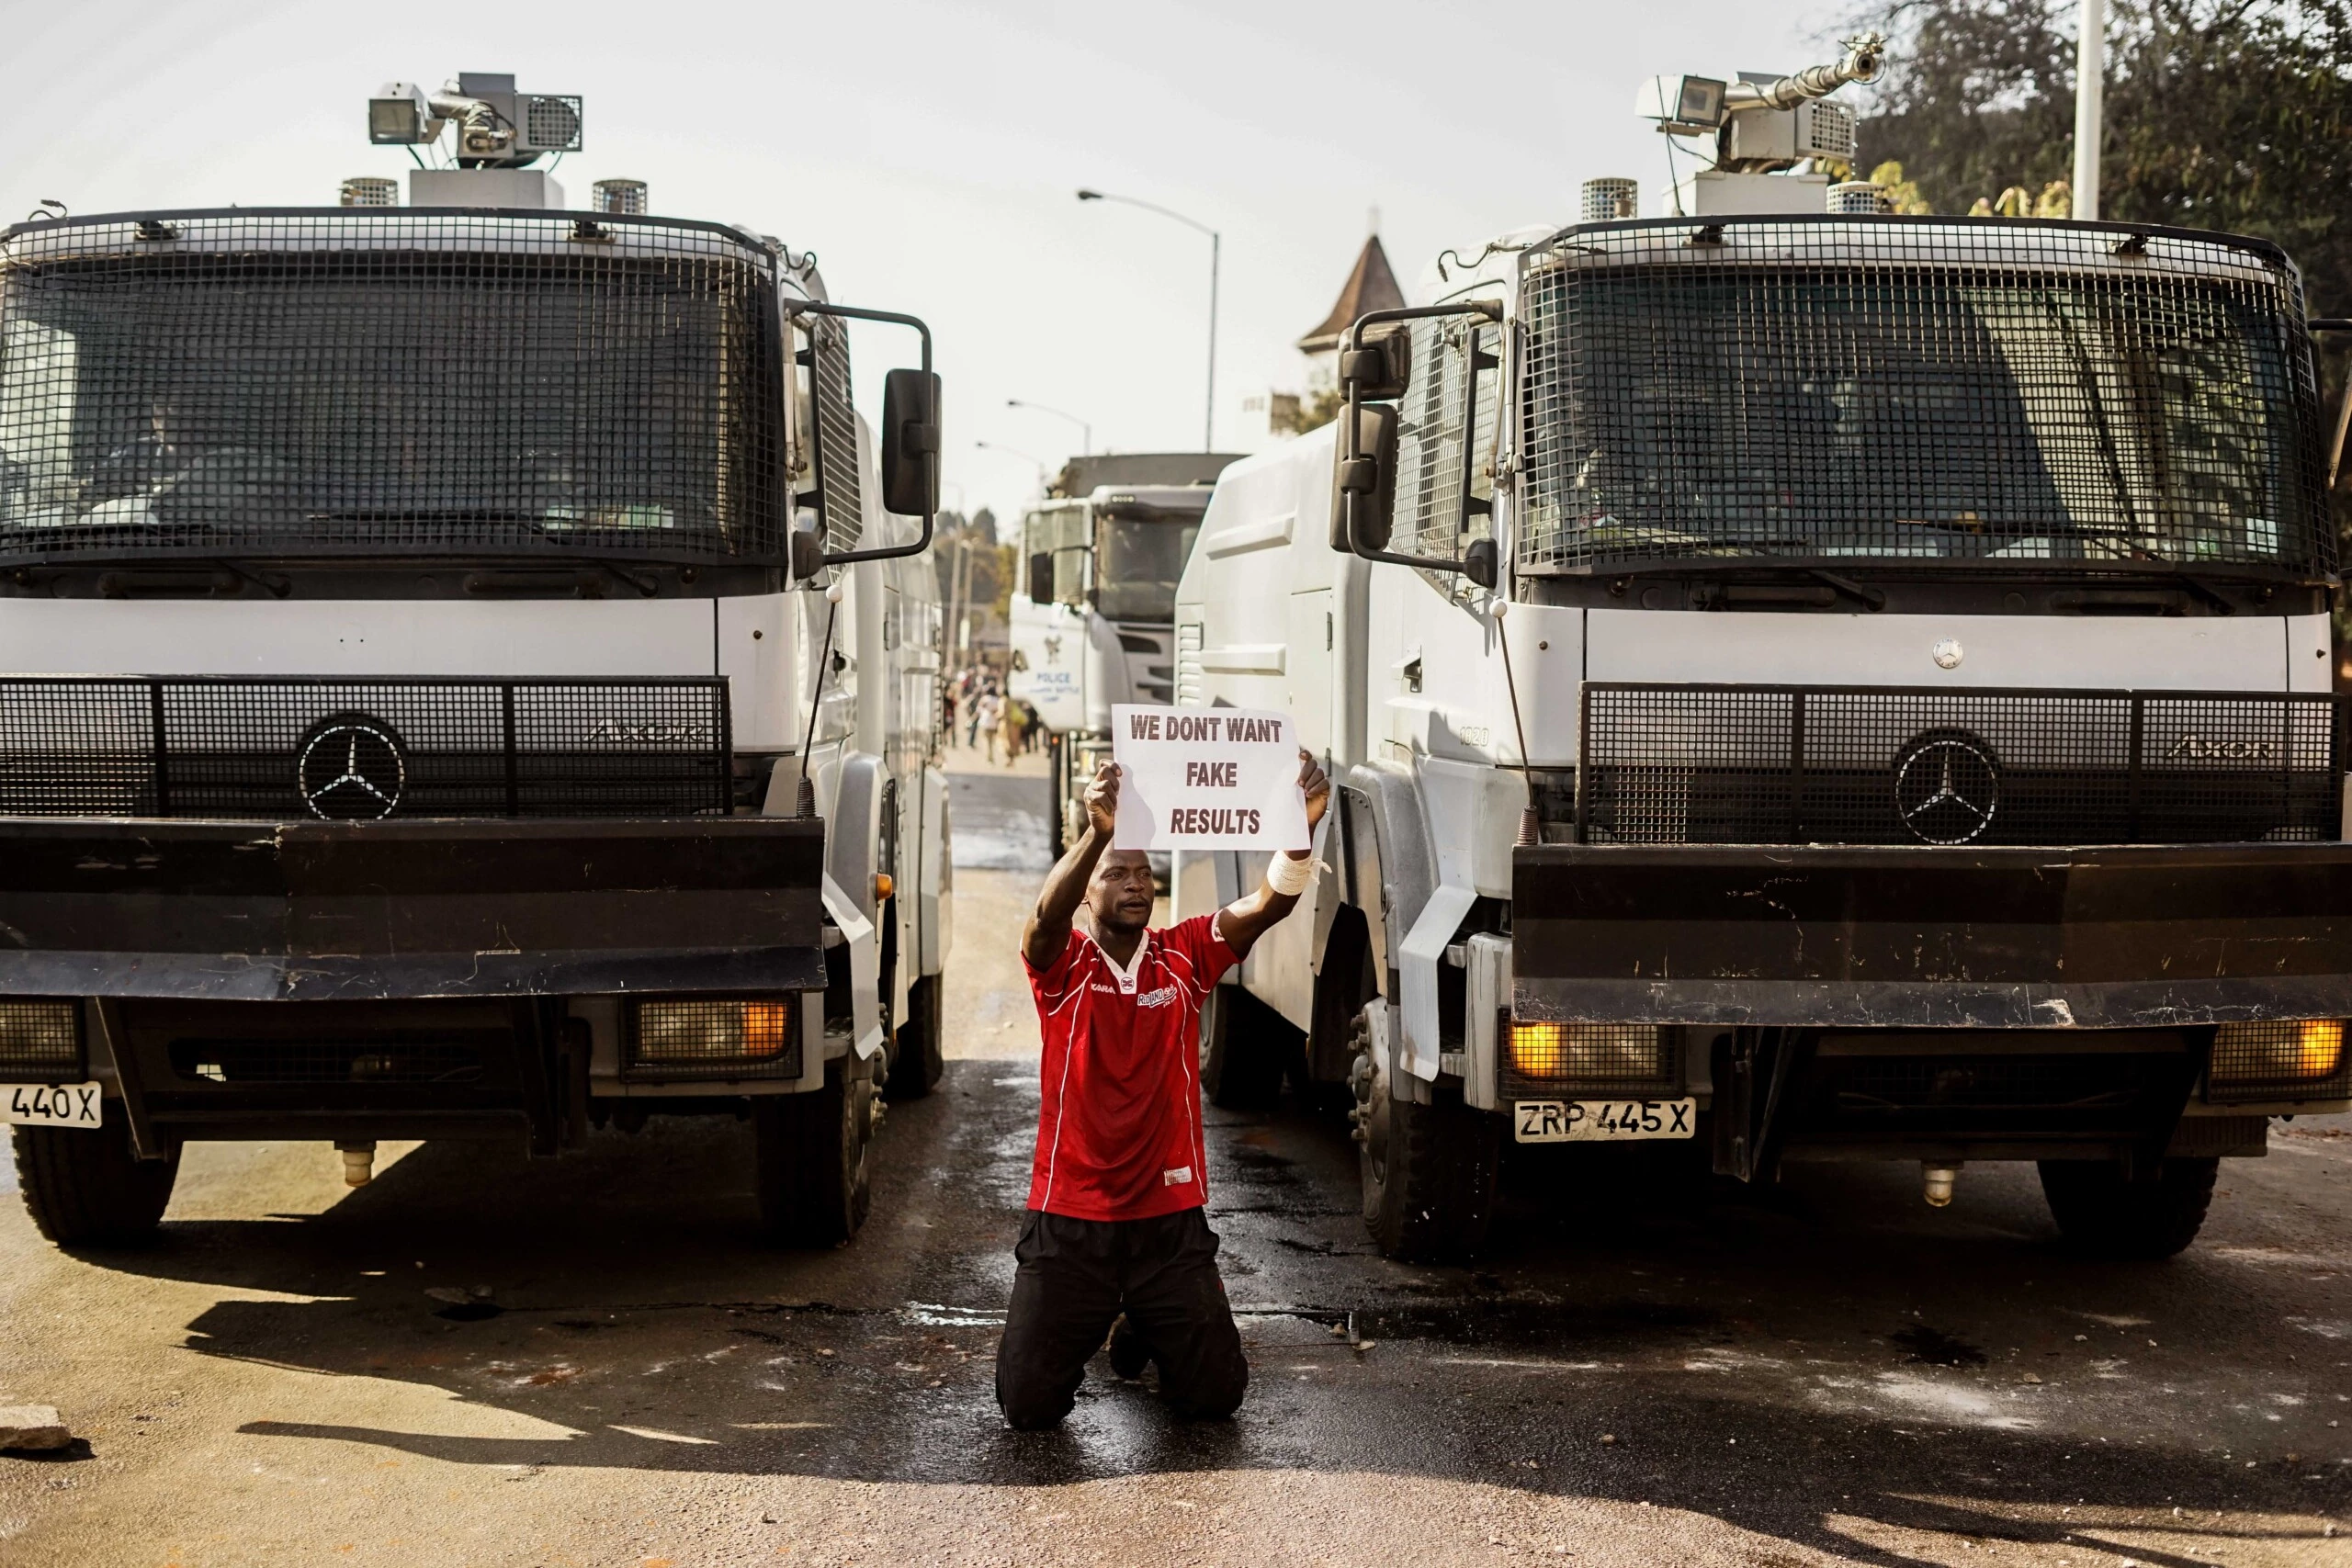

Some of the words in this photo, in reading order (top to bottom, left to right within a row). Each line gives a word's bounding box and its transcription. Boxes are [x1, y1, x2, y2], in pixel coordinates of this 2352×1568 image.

[1036, 672, 1070, 683] POLICE
[1130, 715, 1160, 740] WE
[1166, 716, 1222, 741] DONT
[1227, 717, 1283, 743] WANT
[1460, 727, 1489, 747] 1828
[1186, 762, 1238, 787] FAKE
[1170, 808, 1261, 835] RESULTS
[1520, 1103, 1586, 1136] ZRP
